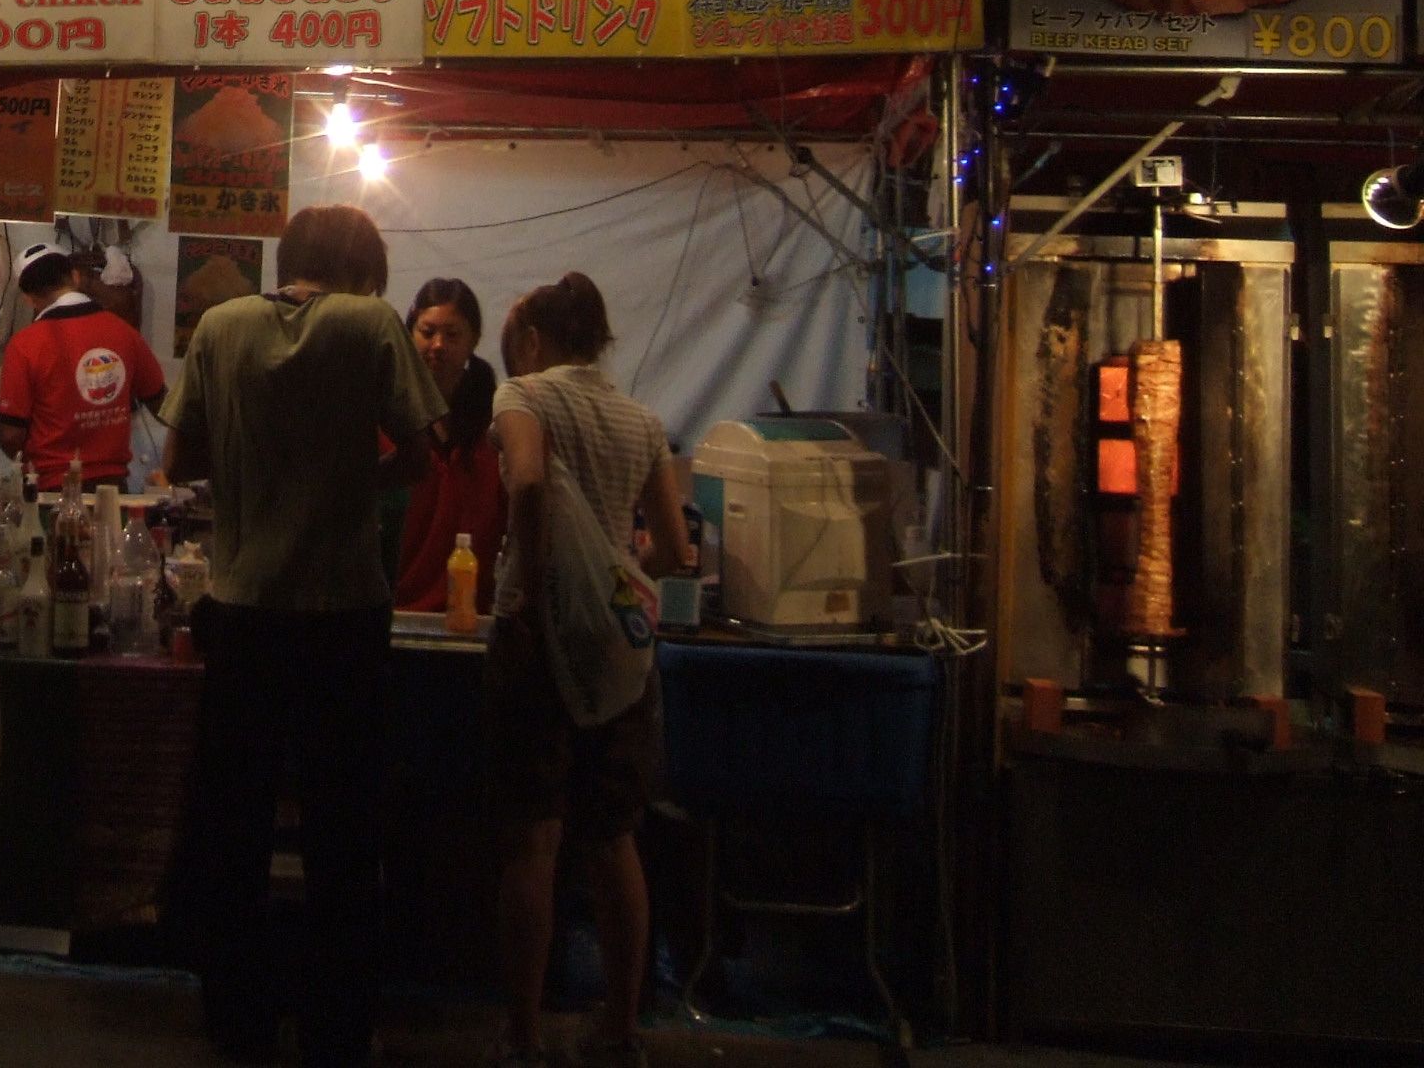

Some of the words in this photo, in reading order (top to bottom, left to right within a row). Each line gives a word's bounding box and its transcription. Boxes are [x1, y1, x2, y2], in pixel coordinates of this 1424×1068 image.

[194, 11, 251, 49] 1本
[269, 10, 382, 49] 400円
[1031, 33, 1077, 47] BEEF
[1083, 34, 1148, 50] KEBAB
[1154, 37, 1193, 52] SET
[1251, 15, 1393, 59] ¥800
